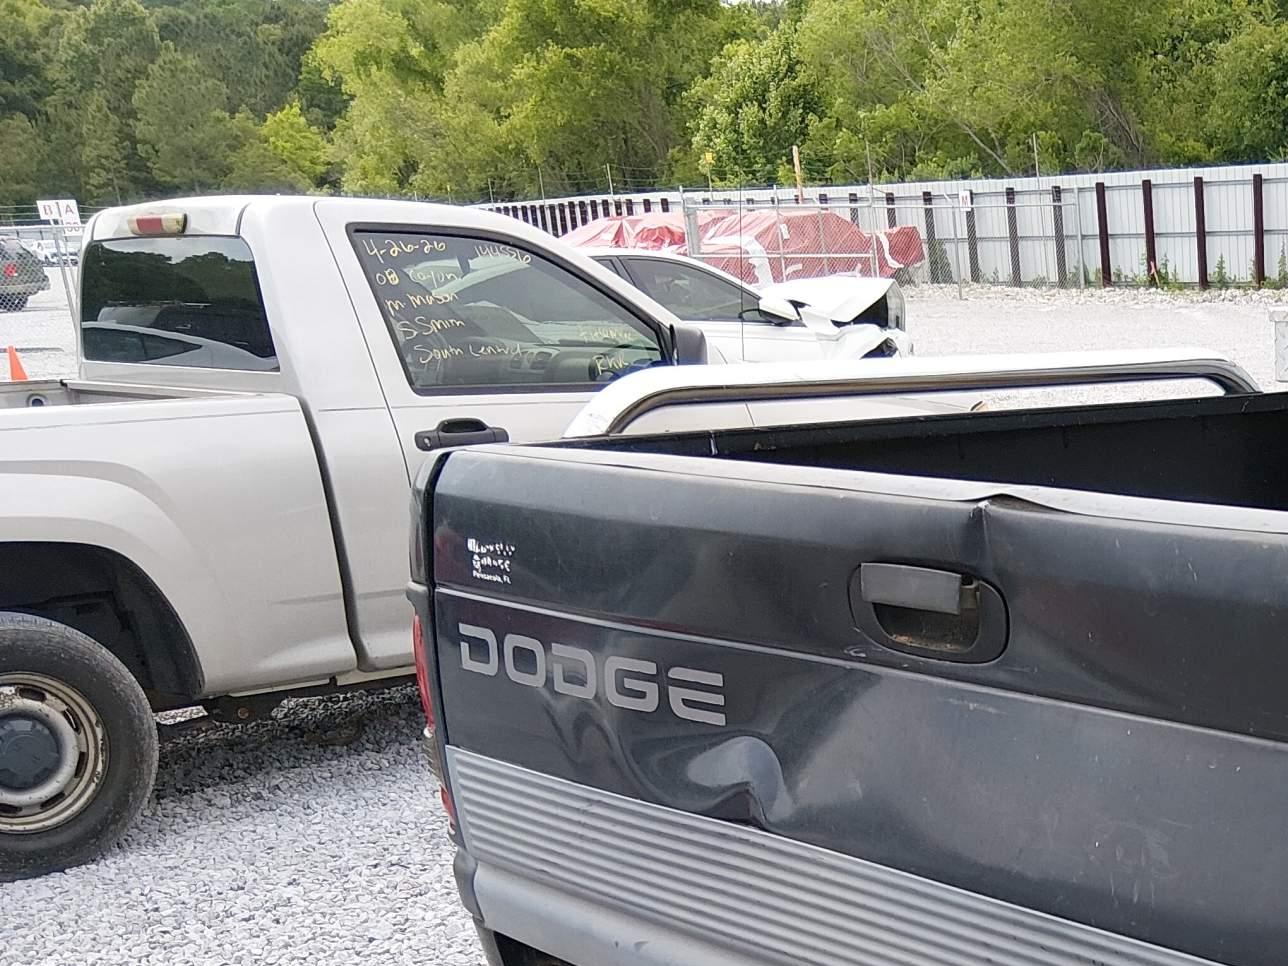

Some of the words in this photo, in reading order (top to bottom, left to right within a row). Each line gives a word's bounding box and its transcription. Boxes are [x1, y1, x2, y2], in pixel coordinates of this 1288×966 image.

[65, 204, 74, 215] A
[363, 239, 446, 264] 4-26-26
[458, 622, 727, 726] DODGE
